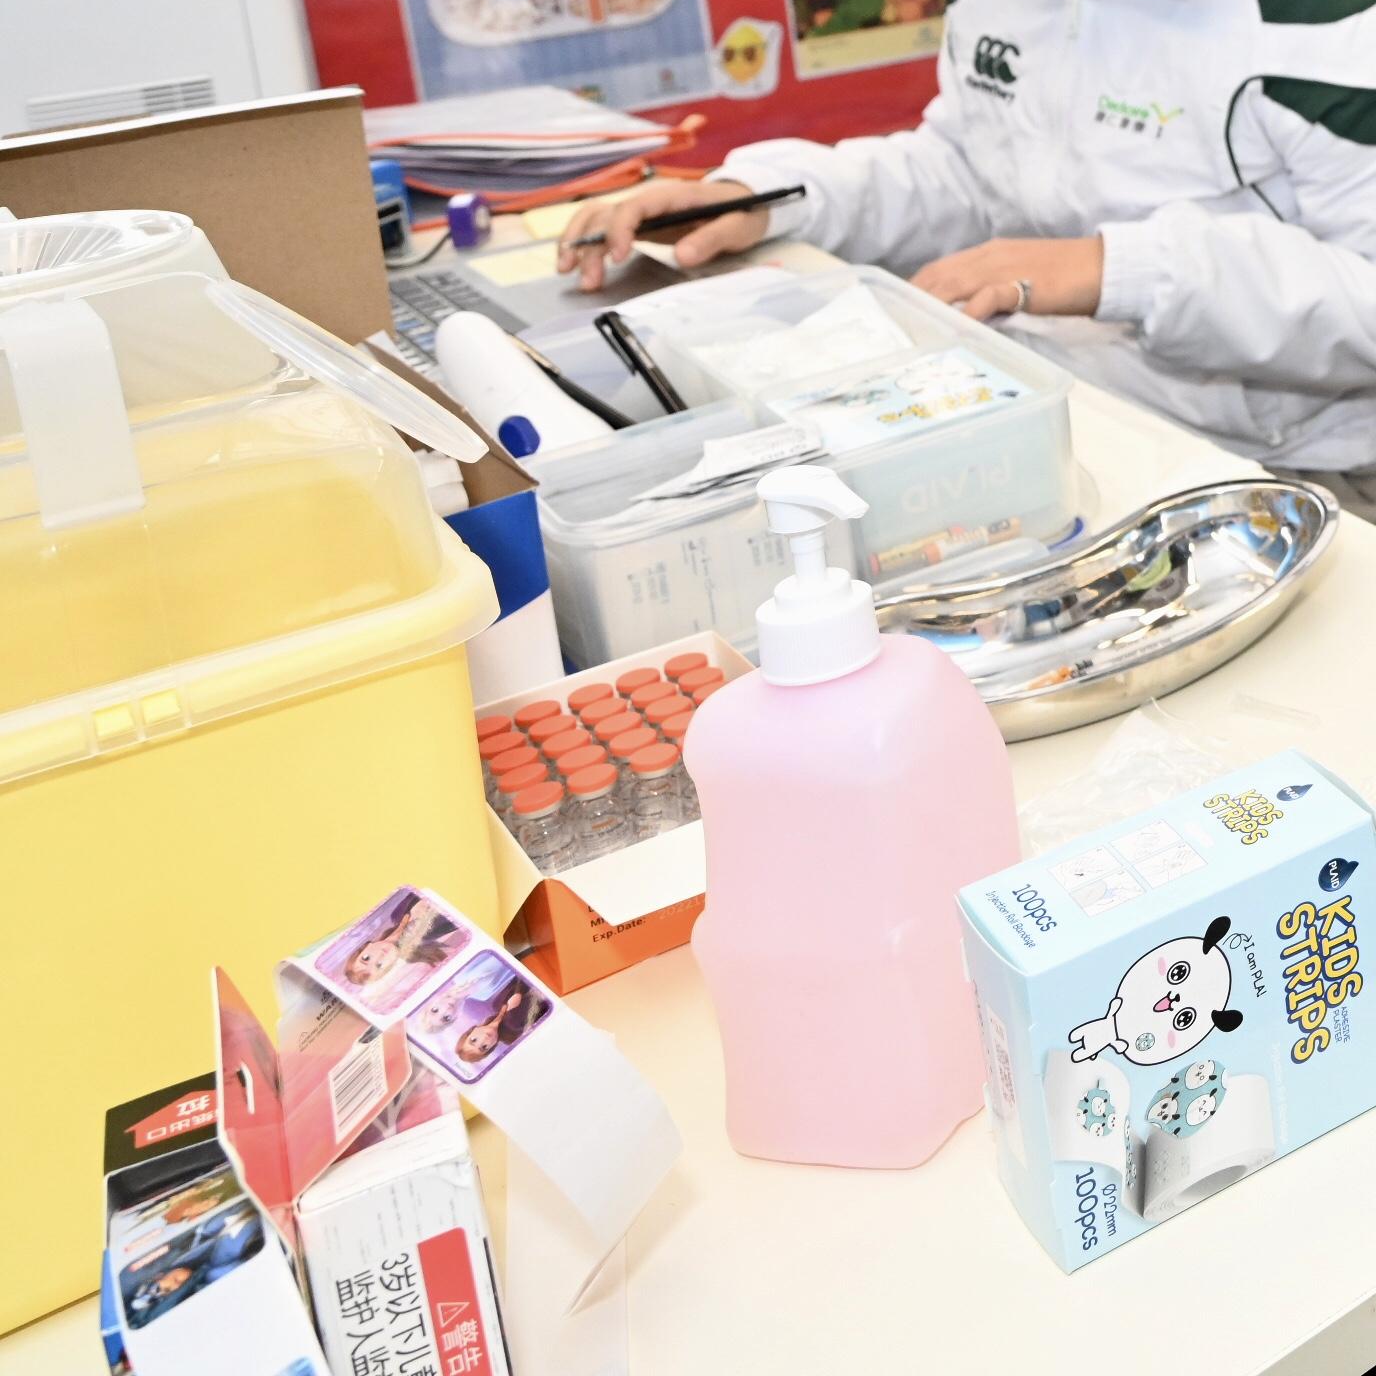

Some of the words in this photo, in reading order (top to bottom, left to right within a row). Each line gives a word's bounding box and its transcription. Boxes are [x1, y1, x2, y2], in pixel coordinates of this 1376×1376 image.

[1203, 794, 1268, 845] STRIPS
[1233, 789, 1284, 825] KIDS
[1328, 860, 1340, 889] PLAID
[1012, 883, 1057, 932] 100pcs
[1244, 941, 1255, 952] I
[1247, 954, 1257, 972] am
[1318, 895, 1363, 1006] KIDS
[1276, 901, 1331, 1064] STRIPS
[1332, 1010, 1343, 1043] PLASTER
[1341, 1006, 1350, 1043] ADHESIVE
[1074, 1166, 1098, 1250] 100pcs
[442, 1319, 483, 1376] 警告
